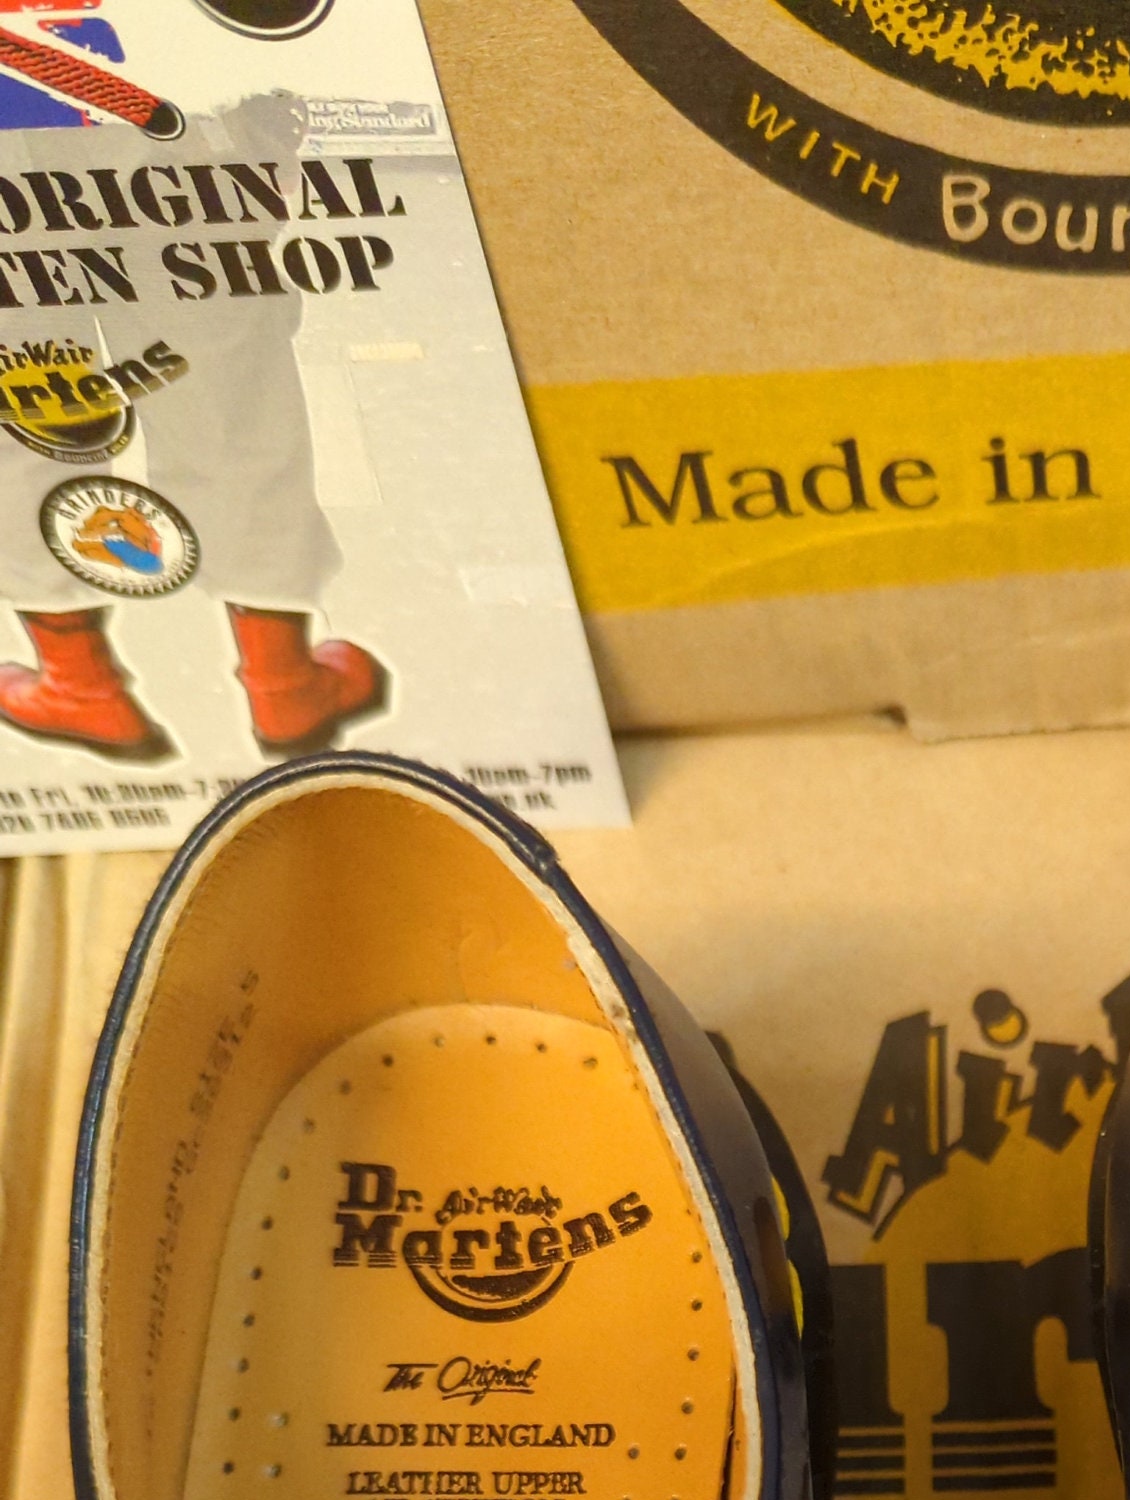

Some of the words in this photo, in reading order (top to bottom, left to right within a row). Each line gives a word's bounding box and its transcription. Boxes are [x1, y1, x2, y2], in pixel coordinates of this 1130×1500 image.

[743, 92, 902, 206] WITH
[161, 235, 395, 300] SHOP
[0, 338, 94, 377] irWair
[601, 438, 939, 530] Made
[982, 437, 1102, 506] in
[337, 1160, 424, 1213] Dr.
[333, 1191, 653, 1269] Martens
[383, 1362, 438, 1392] The
[326, 1423, 419, 1448] MADE
[424, 1423, 463, 1447] IN
[465, 1423, 617, 1448] ENGLAND
[346, 1471, 485, 1495] LEATHER
[493, 1471, 588, 1495] UPPER
